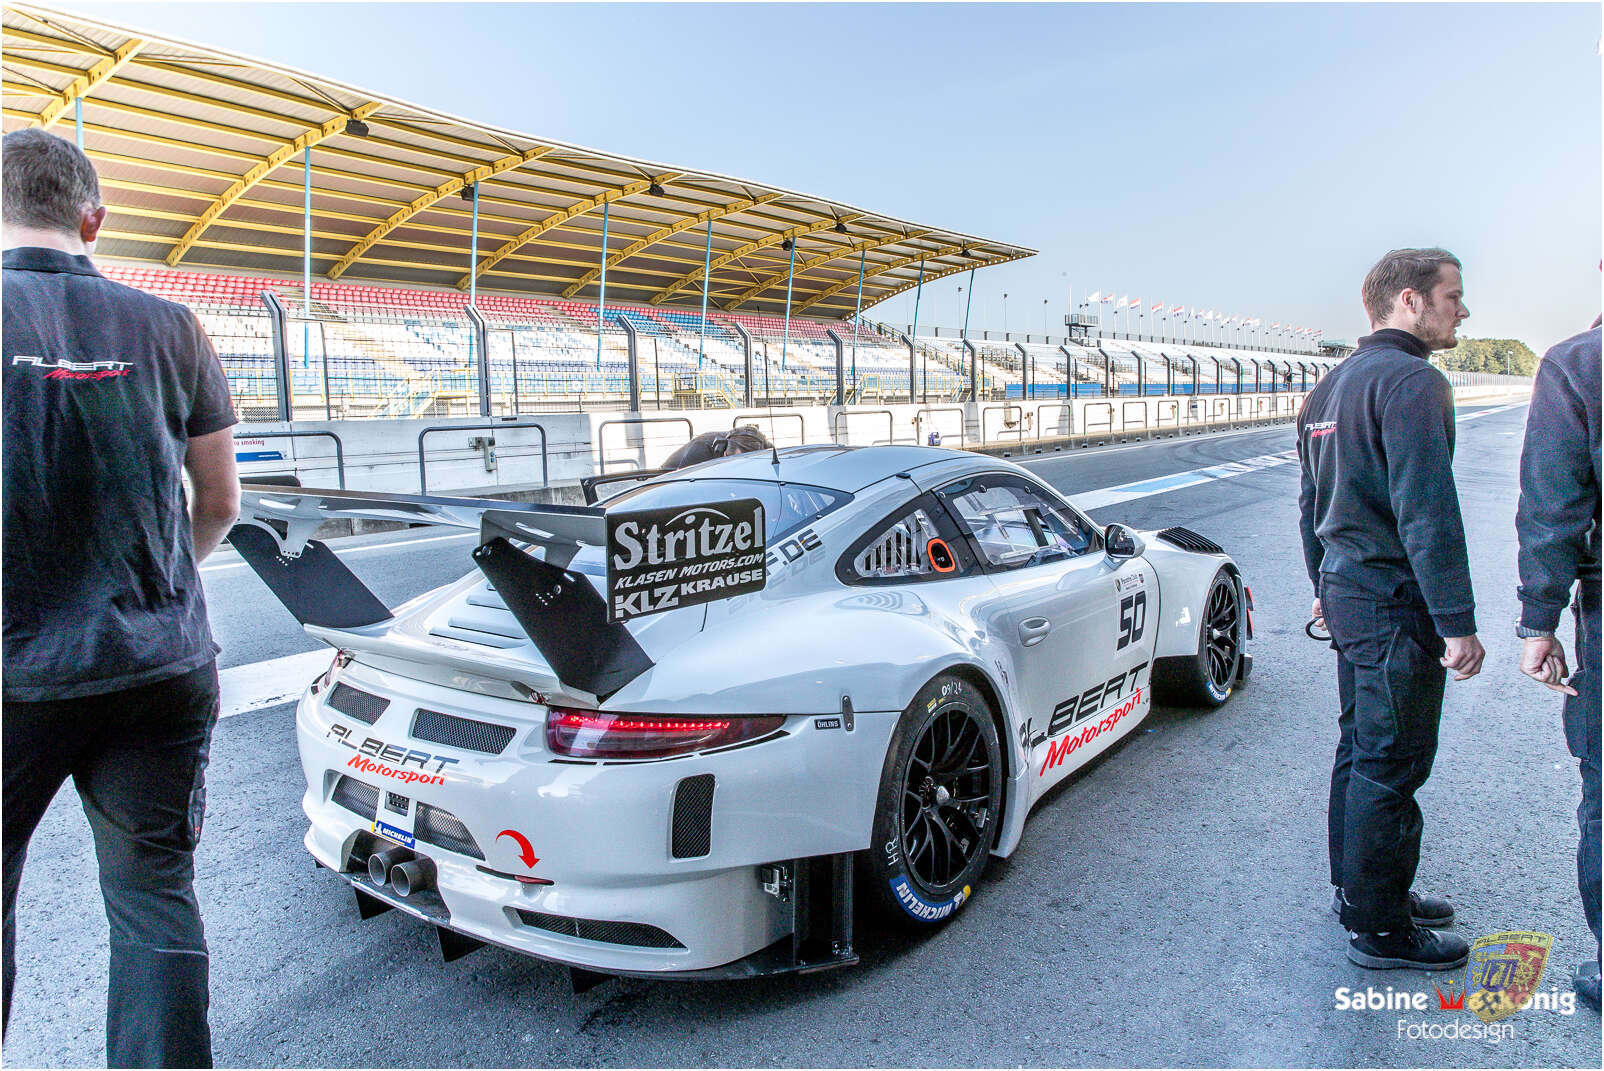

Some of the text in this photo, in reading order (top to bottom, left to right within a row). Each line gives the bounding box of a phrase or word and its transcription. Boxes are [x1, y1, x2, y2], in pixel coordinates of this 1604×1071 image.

[12, 355, 134, 371] ALBERT
[613, 506, 764, 571] Stritzel
[614, 552, 765, 590] KLASEN MOTORS.COM
[615, 568, 763, 619] KLZ KRAUSE
[1117, 590, 1146, 651] 50
[326, 723, 460, 774] ALBERT
[1040, 687, 1143, 777] Motorsport
[382, 827, 412, 844] MICHELIN
[895, 882, 953, 919] MICHELIN
